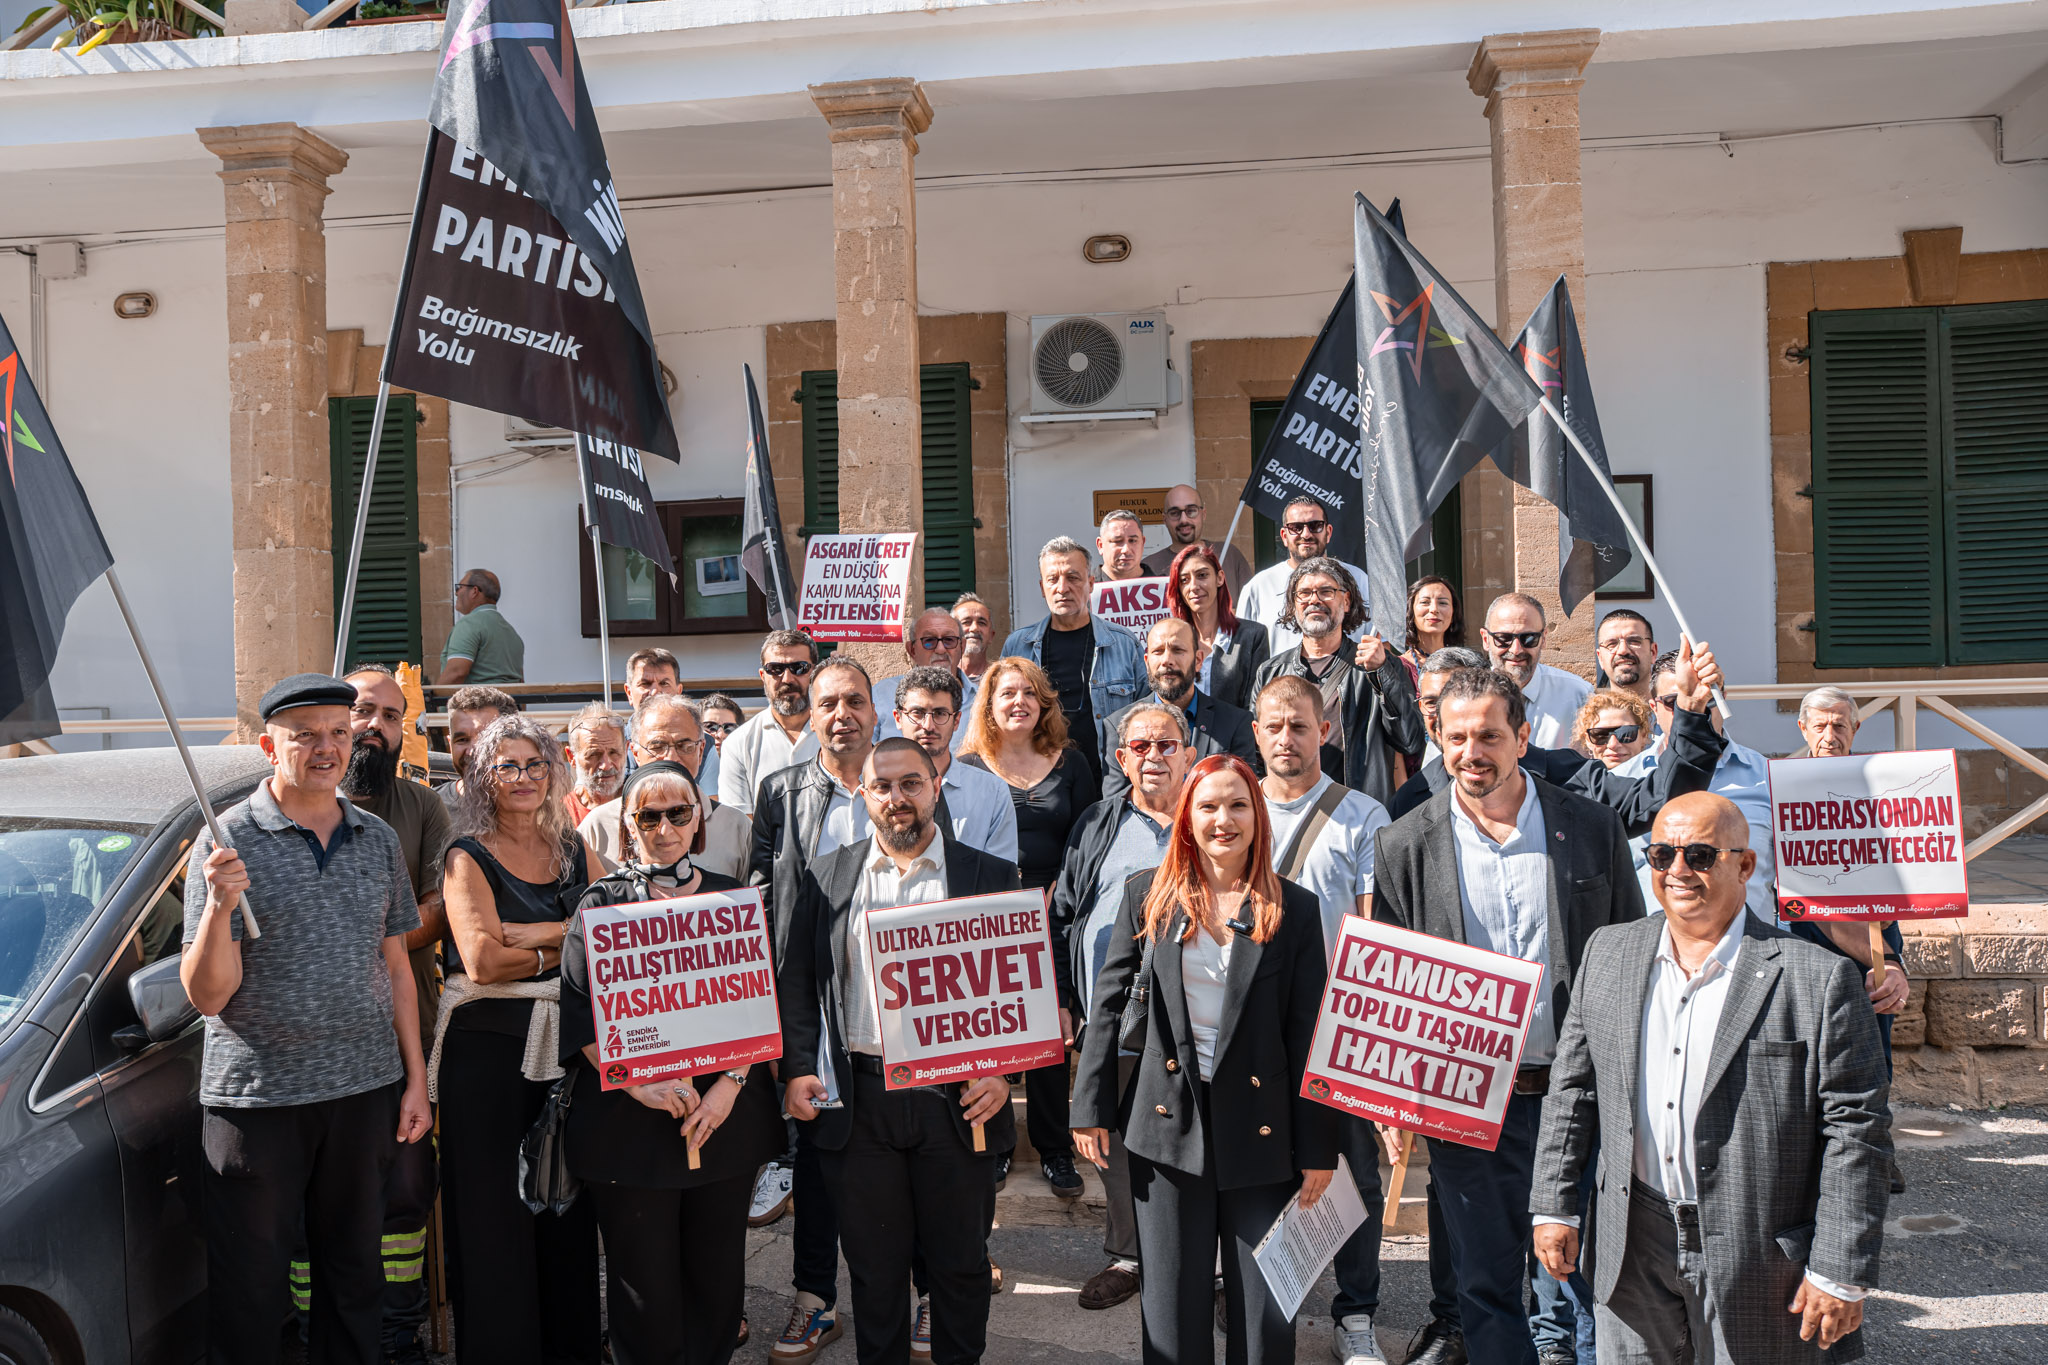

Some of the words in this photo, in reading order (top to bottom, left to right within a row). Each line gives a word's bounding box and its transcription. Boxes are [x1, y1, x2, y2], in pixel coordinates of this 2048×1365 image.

[419, 295, 583, 361] Bağımsızlık
[1129, 320, 1154, 328] AUX
[417, 328, 476, 366] Yolu
[1283, 412, 1363, 480] PARTİS
[1258, 474, 1288, 501] Yolu
[1264, 458, 1345, 511] Bağımsızlık
[810, 538, 863, 558] ASGARİ
[865, 538, 911, 558] ÜCRET
[823, 564, 841, 578] EN
[844, 561, 890, 582] DÜŞÜK
[803, 599, 900, 624] EŞİTLENSİN
[806, 584, 842, 598] KAMU
[844, 584, 901, 602] MAAŞINA
[1778, 795, 1954, 832] FEDERASYONDAN
[1780, 831, 1957, 873] VAZGEÇMEYECEĞİZ
[592, 903, 760, 954] SENDİKASIZ
[1809, 904, 1870, 916] Bağımsızlık
[1872, 904, 1895, 914] Yolu
[876, 925, 933, 954] ULTRA
[935, 910, 1042, 946] ZENGİNLERE
[595, 935, 766, 992] ÇALIŞTIRILMAK
[880, 941, 1045, 1010] SERVET
[1344, 941, 1520, 1023] KAMUSAL
[597, 968, 772, 1022] YASAKLANSIN!
[626, 1026, 658, 1037] SENDİKA
[627, 1034, 659, 1045] EMNİYET
[913, 997, 1028, 1047] VERGİSİ
[1330, 987, 1412, 1033] TOPLU
[1417, 1011, 1514, 1062] TAŞIMA
[628, 1040, 671, 1053] KEMERİDİR!
[632, 1058, 692, 1078] Bağımsızlık
[693, 1055, 717, 1067] Yolu
[915, 1062, 974, 1079] Bağımsızlık
[975, 1058, 998, 1070] Yolu
[1335, 1031, 1485, 1104] HAKTIR
[1332, 1090, 1397, 1119] Bağımsızlık
[1399, 1109, 1424, 1126] Yolu
